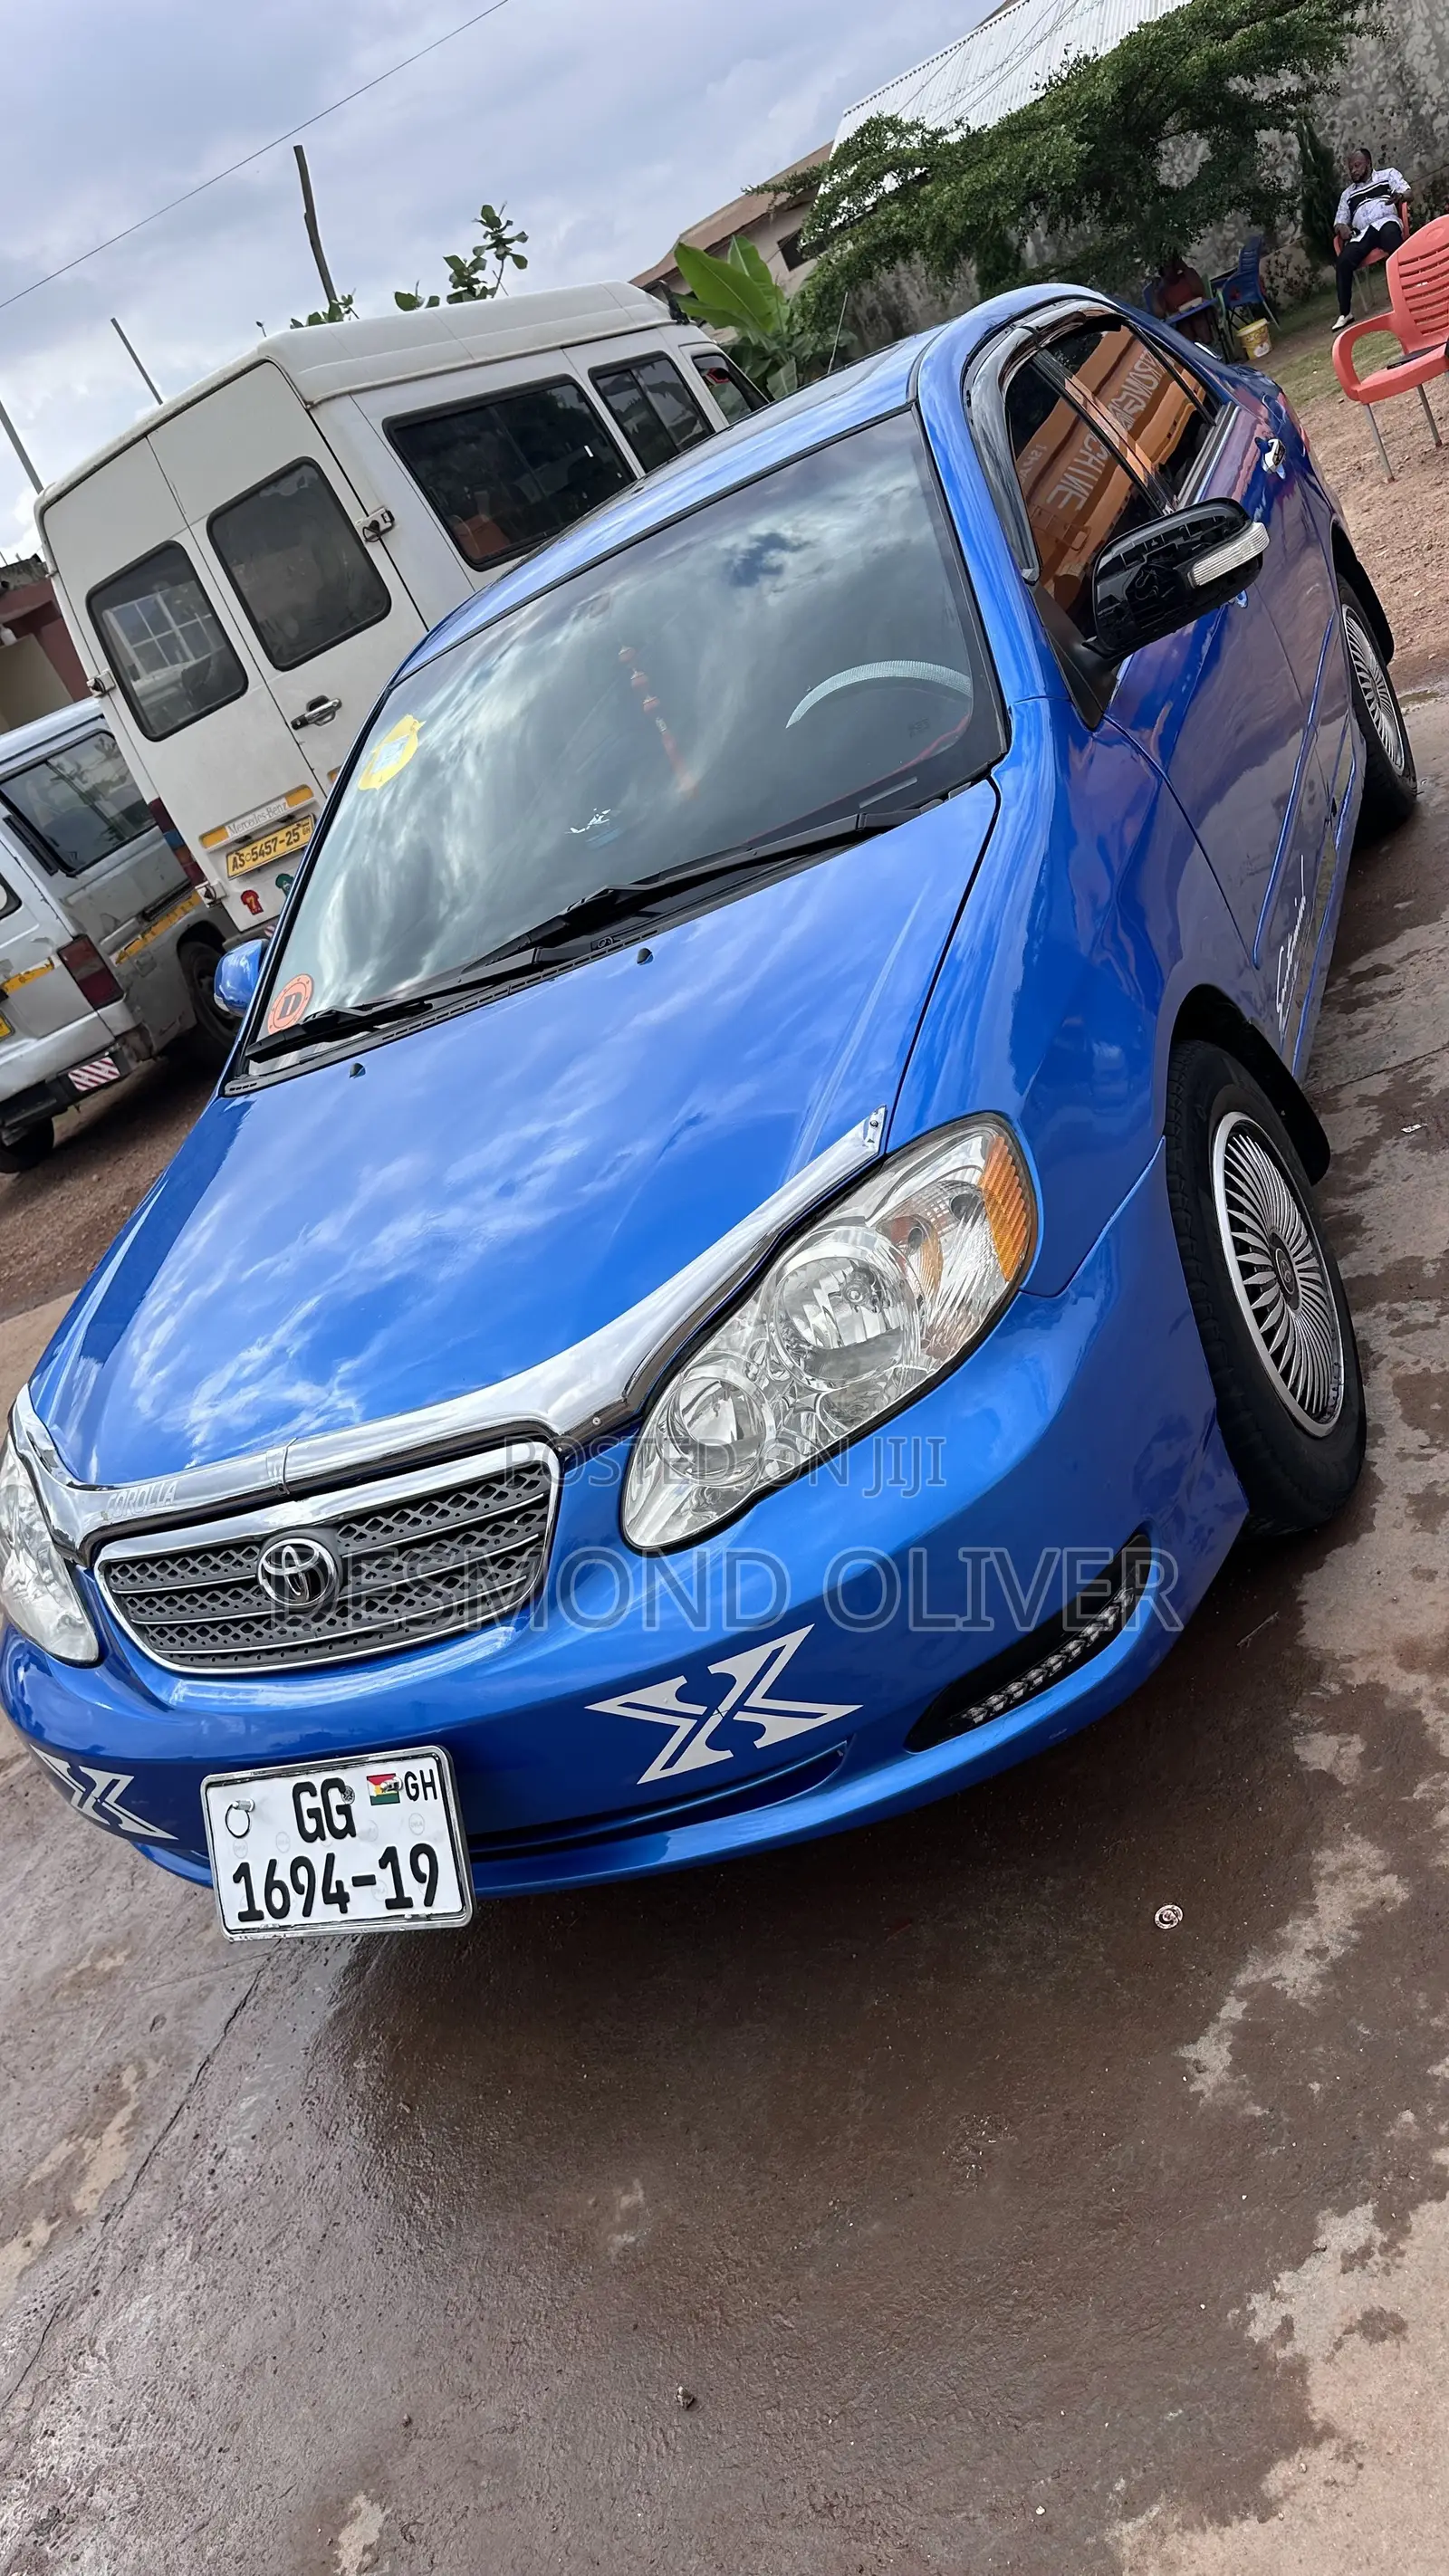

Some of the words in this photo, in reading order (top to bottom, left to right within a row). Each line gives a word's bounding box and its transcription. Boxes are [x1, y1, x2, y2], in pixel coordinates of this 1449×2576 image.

[227, 800, 288, 835] Mercedes-Benz
[231, 853, 245, 872] AS
[250, 826, 302, 862] 5457-25
[106, 1480, 179, 1520] COROLLA
[292, 1777, 357, 1843] GG
[404, 1770, 438, 1801] GH
[232, 1843, 439, 1922] 1694-19
